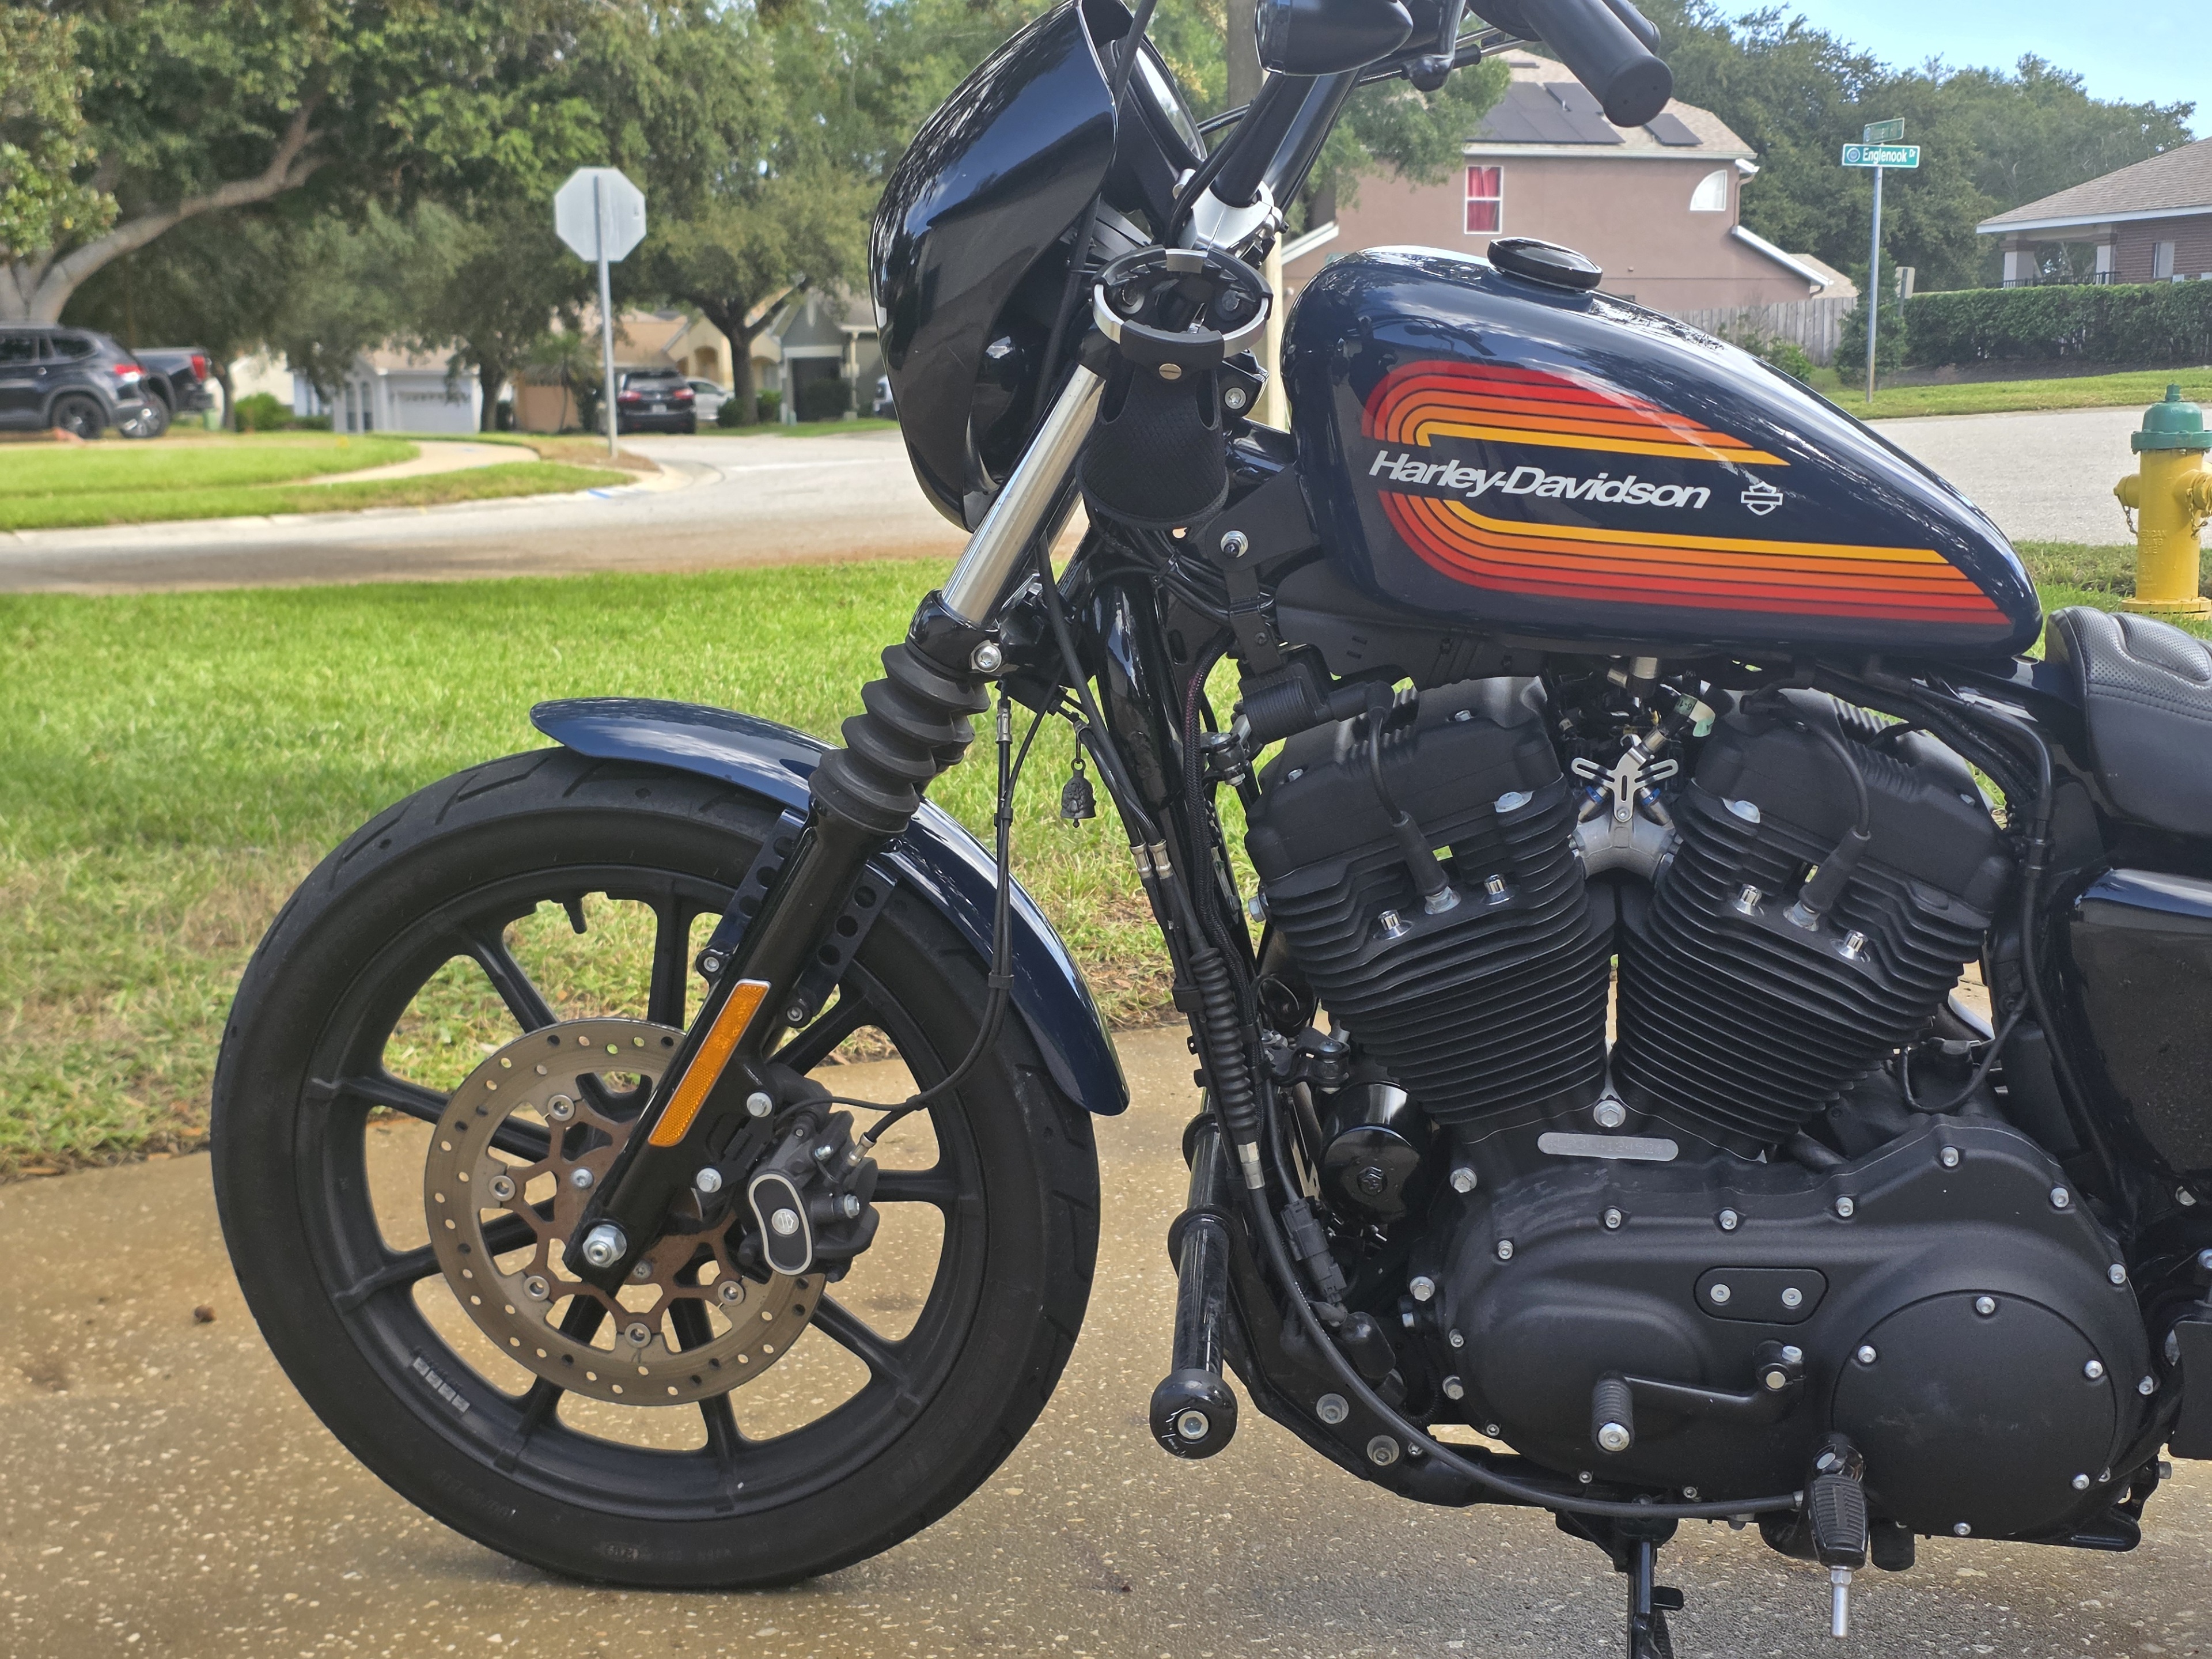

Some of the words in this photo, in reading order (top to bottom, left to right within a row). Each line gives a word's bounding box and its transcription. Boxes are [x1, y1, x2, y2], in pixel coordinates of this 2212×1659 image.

[1863, 147, 1907, 164] Englenook
[1909, 149, 1916, 158] Dr
[1369, 450, 1711, 509] Harley-Davidson
